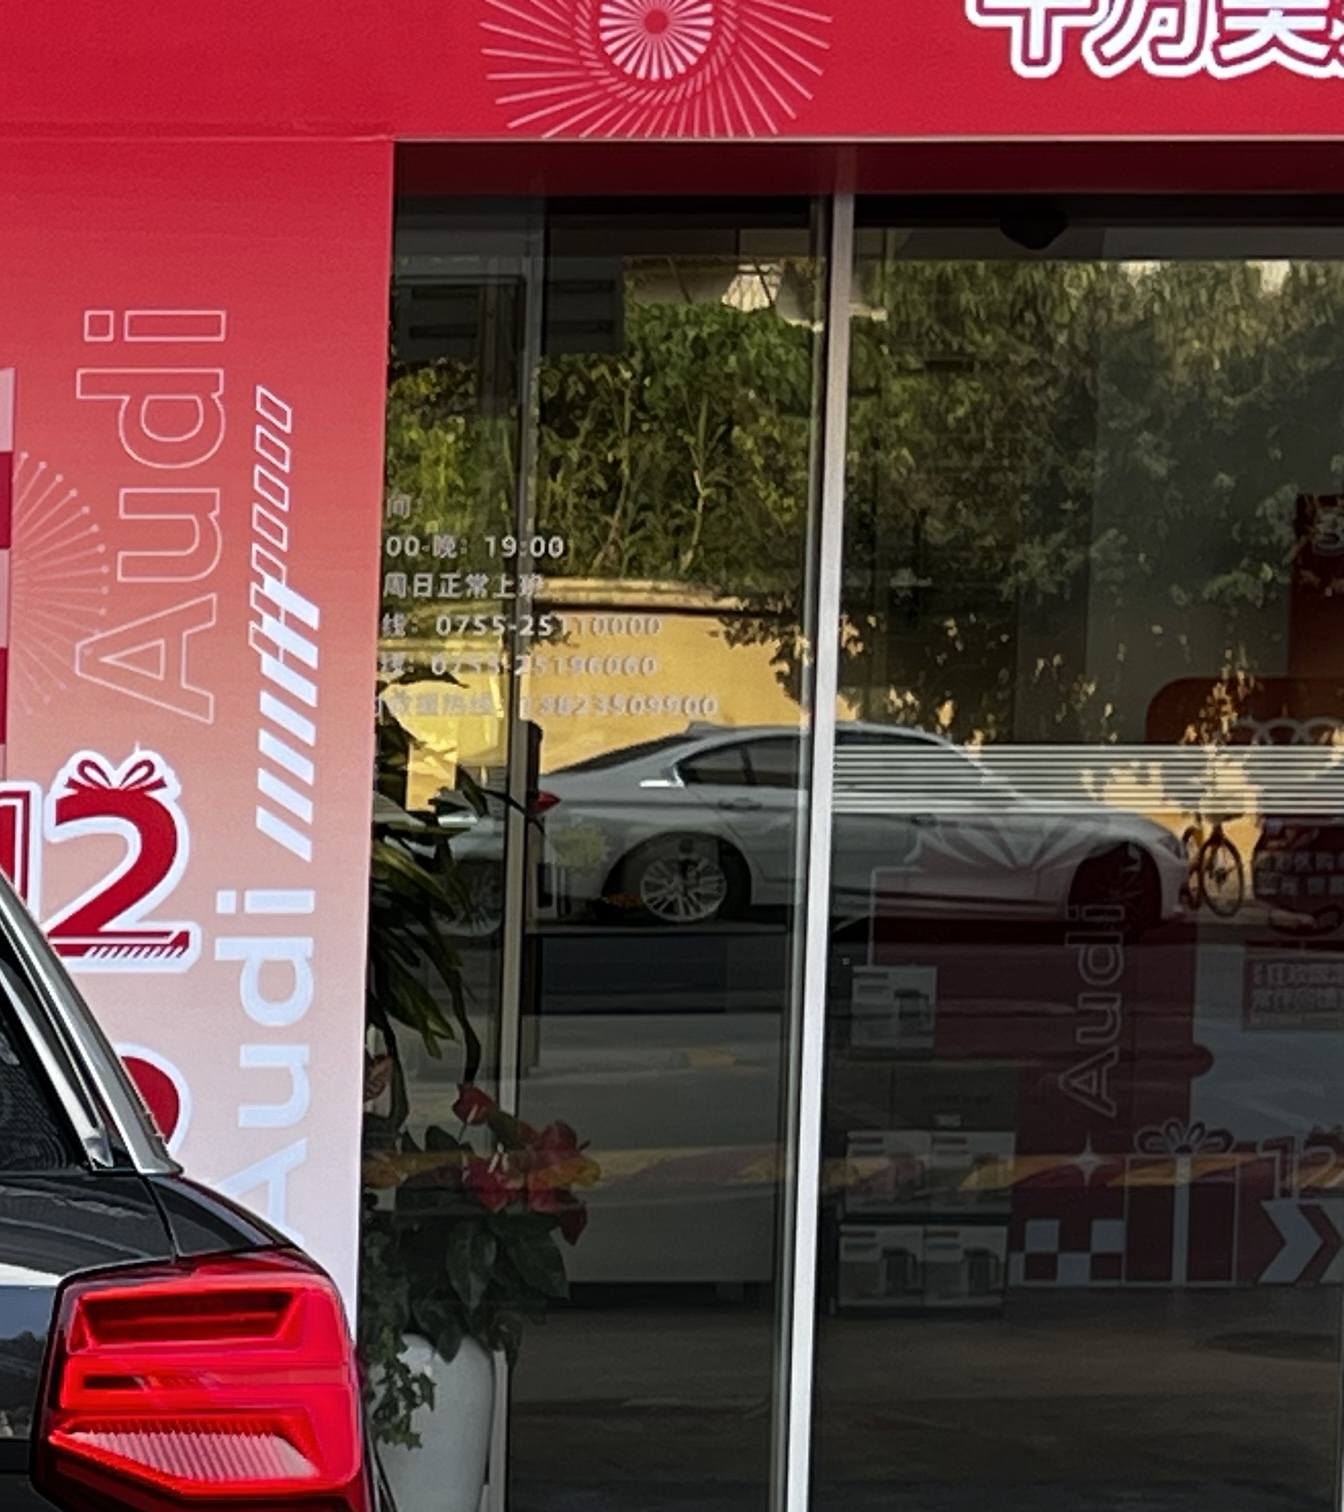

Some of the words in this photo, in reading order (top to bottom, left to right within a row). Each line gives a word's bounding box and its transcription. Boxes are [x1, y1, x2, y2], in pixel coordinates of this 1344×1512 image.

[76, 310, 226, 724] Audi
[205, 889, 316, 1245] Audi
[1058, 903, 1125, 1119] Audi
